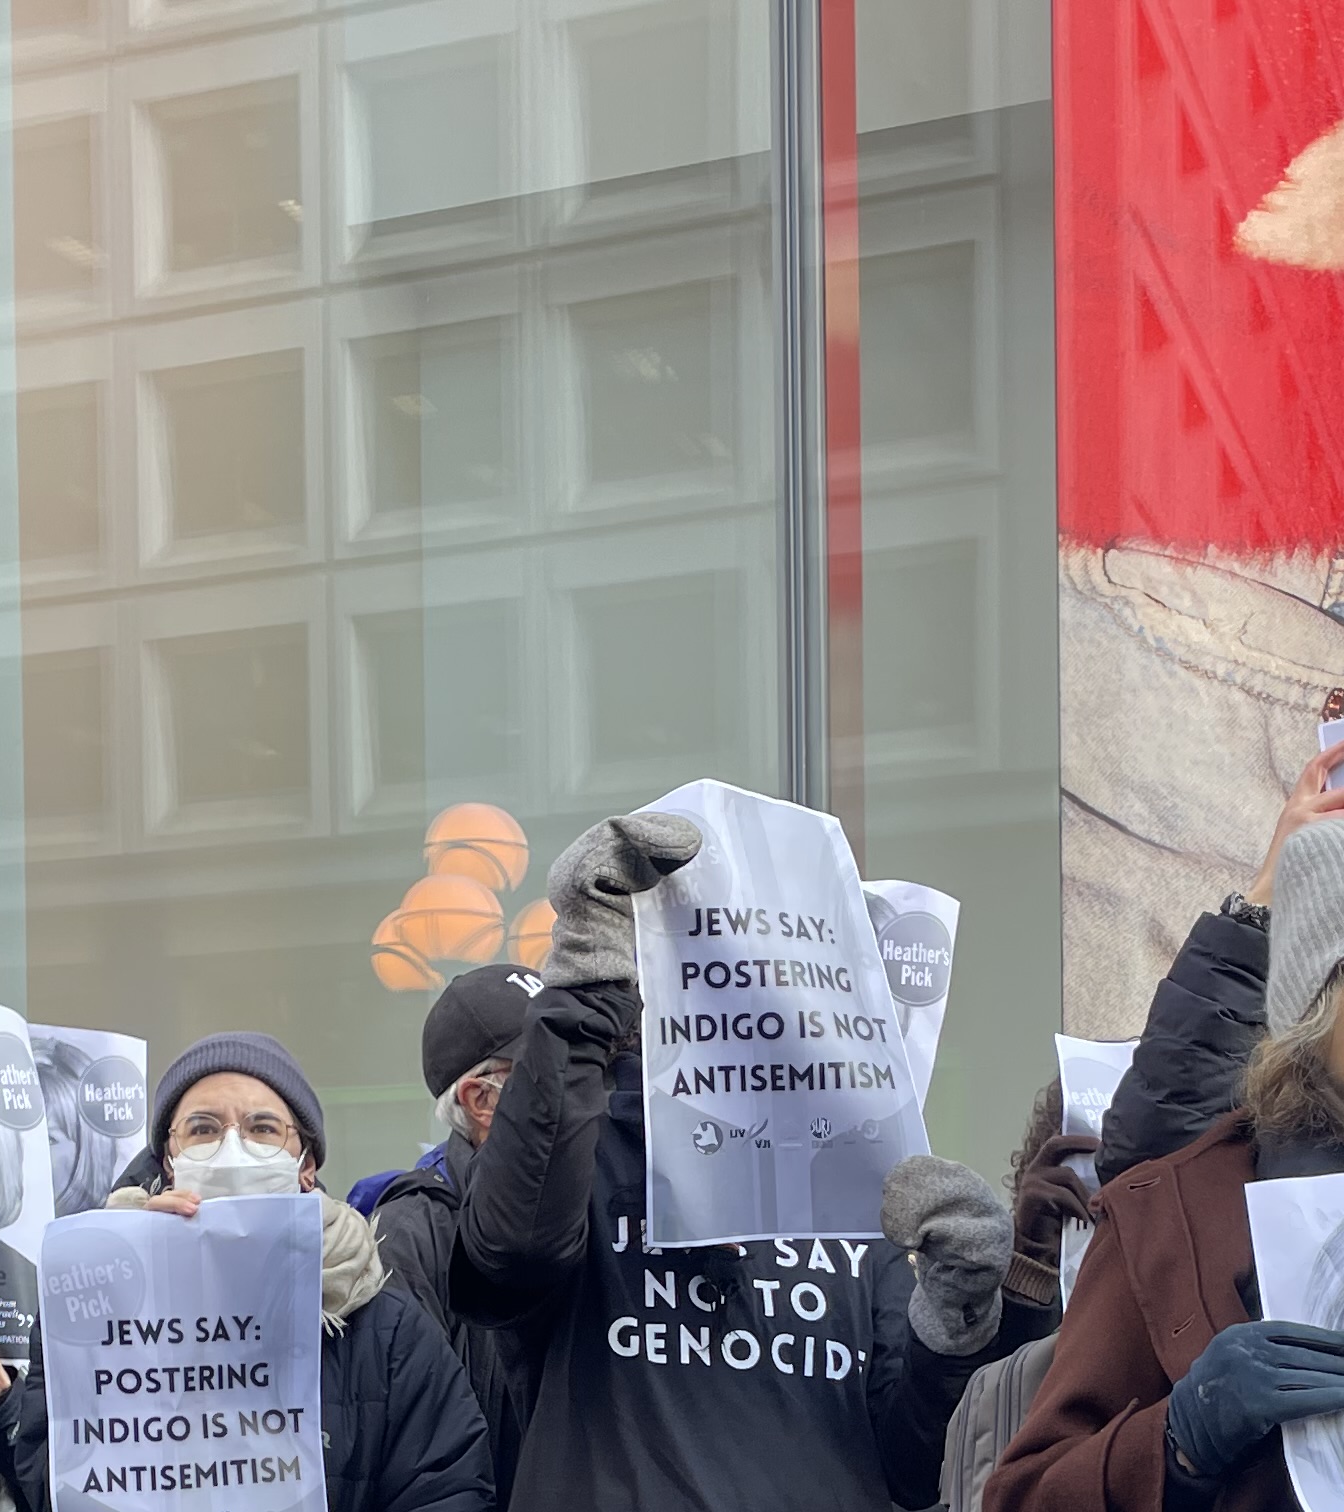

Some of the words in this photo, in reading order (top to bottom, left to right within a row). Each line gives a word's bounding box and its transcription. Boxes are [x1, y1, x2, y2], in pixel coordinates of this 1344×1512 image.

[688, 908, 771, 937] JEWS
[778, 911, 836, 944] SAY:
[882, 939, 950, 967] Heather's
[681, 959, 852, 993] POSTERING
[901, 964, 933, 988] Pick
[659, 1011, 785, 1045] INDIGO
[798, 1010, 825, 1039] IS
[833, 1011, 886, 1043] NOT
[84, 1082, 145, 1102] Heather's
[671, 1062, 896, 1097] ANTISEMITISM
[2, 1088, 33, 1110] Pick
[103, 1103, 135, 1122] Pick
[773, 1237, 868, 1278] SAY
[64, 1291, 114, 1323] Pick
[644, 1268, 725, 1313] NO
[753, 1279, 827, 1321] TO
[101, 1317, 185, 1346] JEWS
[195, 1314, 261, 1343] SAY:
[94, 1361, 269, 1395] POSTERING
[73, 1415, 191, 1445] INDIGO
[202, 1412, 229, 1440] IS
[238, 1407, 304, 1437] NOT
[82, 1455, 301, 1494] ANTISEMITISM
